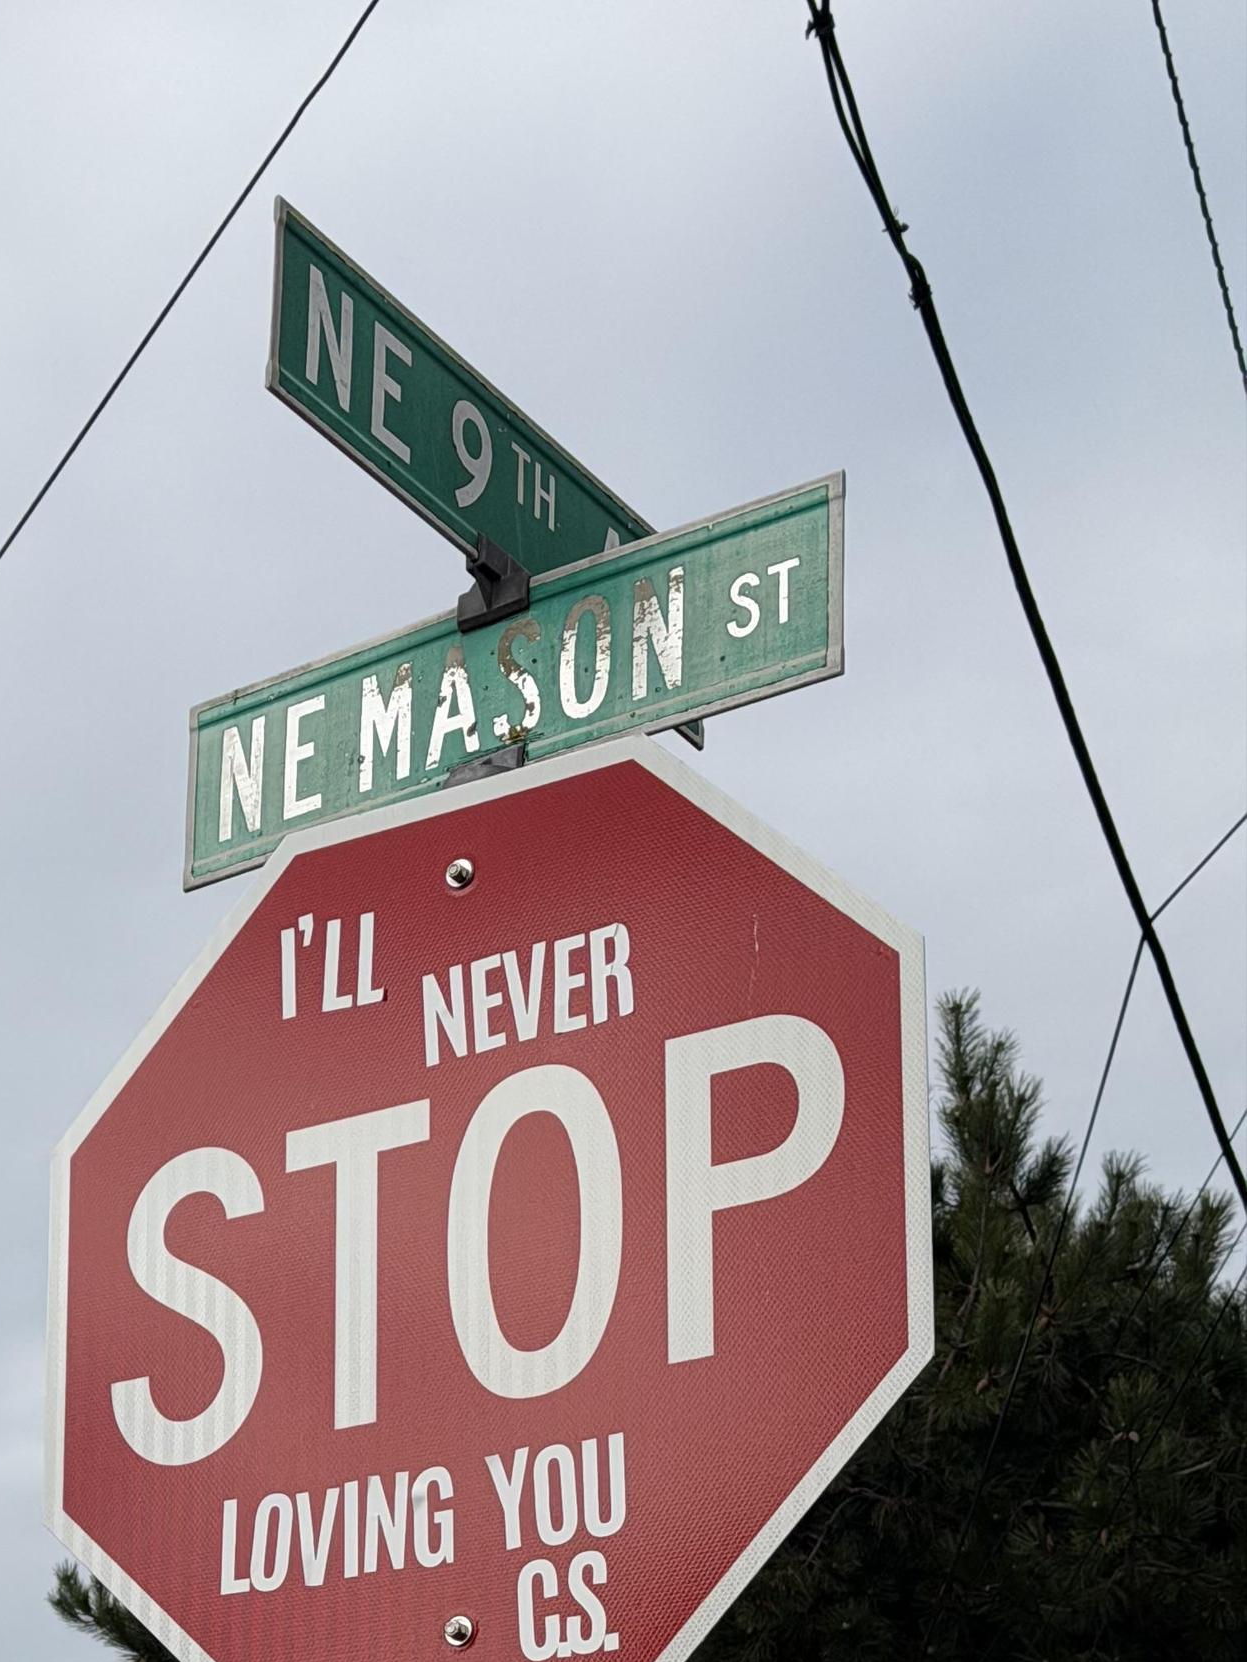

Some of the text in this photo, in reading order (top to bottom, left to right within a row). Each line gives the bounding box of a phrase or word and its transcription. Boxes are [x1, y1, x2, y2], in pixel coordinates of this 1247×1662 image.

[305, 264, 556, 532] NE 9 TH
[218, 557, 801, 843] NE MASON ST
[422, 922, 635, 1067] NEVER
[110, 1013, 846, 1466] STOP
[219, 1433, 626, 1596] LOVING YOU
